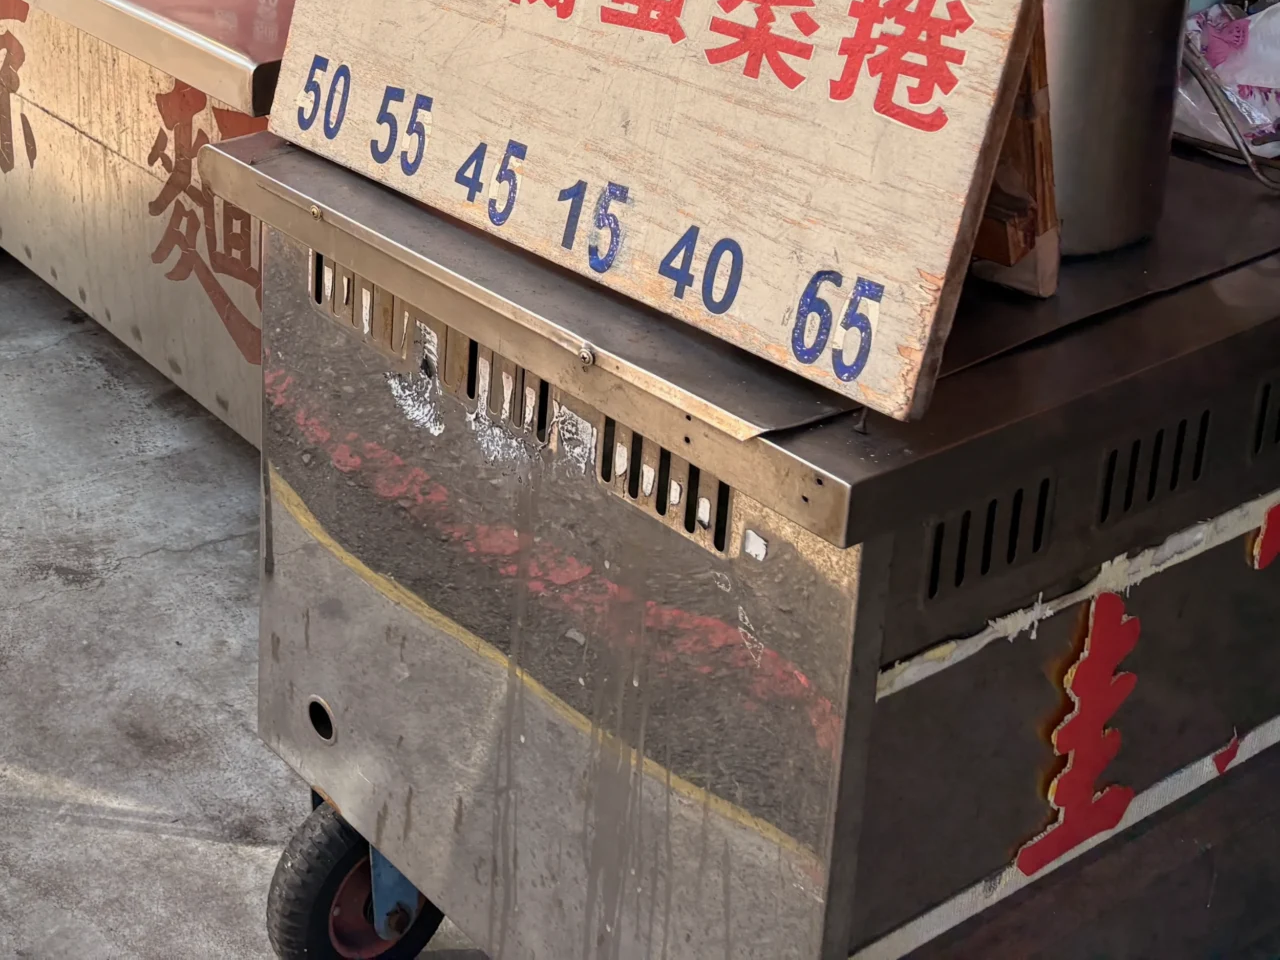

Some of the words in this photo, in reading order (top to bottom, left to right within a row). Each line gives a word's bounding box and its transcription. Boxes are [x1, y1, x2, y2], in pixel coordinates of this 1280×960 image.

[295, 54, 351, 140] 50
[369, 85, 434, 177] 55
[453, 140, 528, 226] 45
[557, 178, 630, 275] 15
[658, 224, 745, 316] 40
[790, 269, 885, 385] 65
